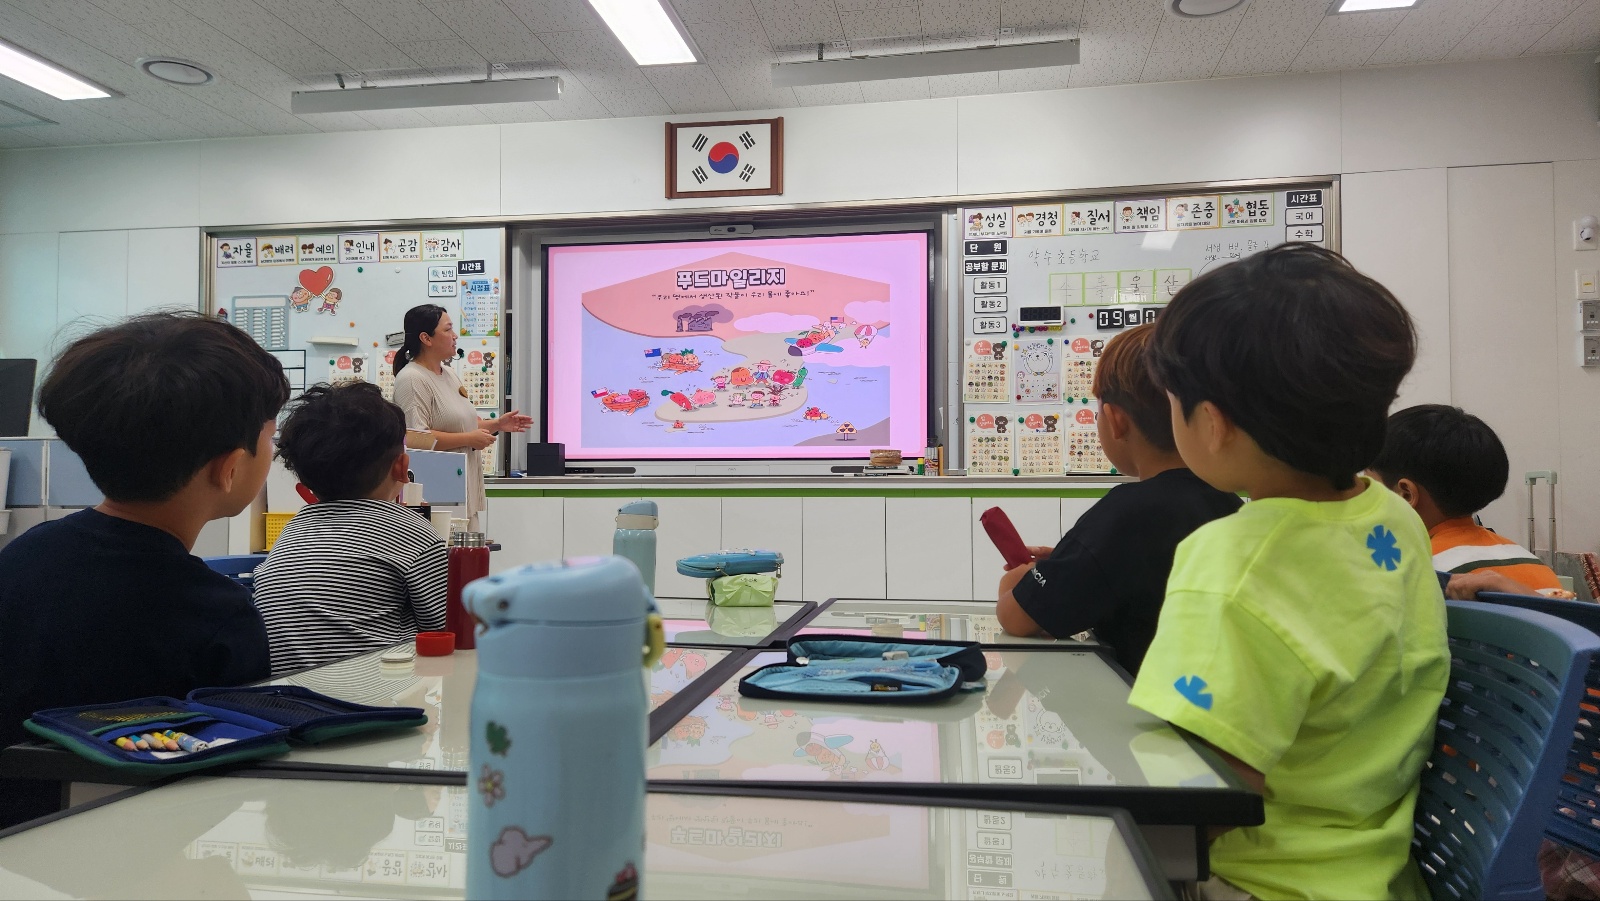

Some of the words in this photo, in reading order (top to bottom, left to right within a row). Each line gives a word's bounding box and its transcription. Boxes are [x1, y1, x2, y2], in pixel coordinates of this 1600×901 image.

[1291, 193, 1317, 204] 시간표
[1137, 206, 1160, 221] 책임
[1191, 202, 1215, 219] 존중
[1246, 199, 1269, 217] 협동
[986, 212, 1006, 228] 성실
[1036, 211, 1058, 226] 경청
[1088, 209, 1110, 225] 질서
[1296, 212, 1313, 220] 국어
[1295, 230, 1313, 238] 수학
[233, 243, 253, 258] 자율
[275, 244, 294, 254] 배려
[316, 244, 334, 254] 예의
[356, 241, 375, 253] 인내
[398, 239, 418, 252] 공감
[441, 238, 461, 252] 감사
[970, 243, 979, 253] 단
[993, 242, 1002, 252] 원
[461, 263, 481, 271] 시간표
[966, 262, 989, 271] 공부할
[991, 261, 1006, 271] 문제
[677, 268, 786, 290] 푸드마일리지
[980, 281, 1001, 290] 활동1
[981, 300, 1001, 309] 활동2
[1100, 310, 1123, 327] 09
[980, 321, 1001, 330] 활동3
